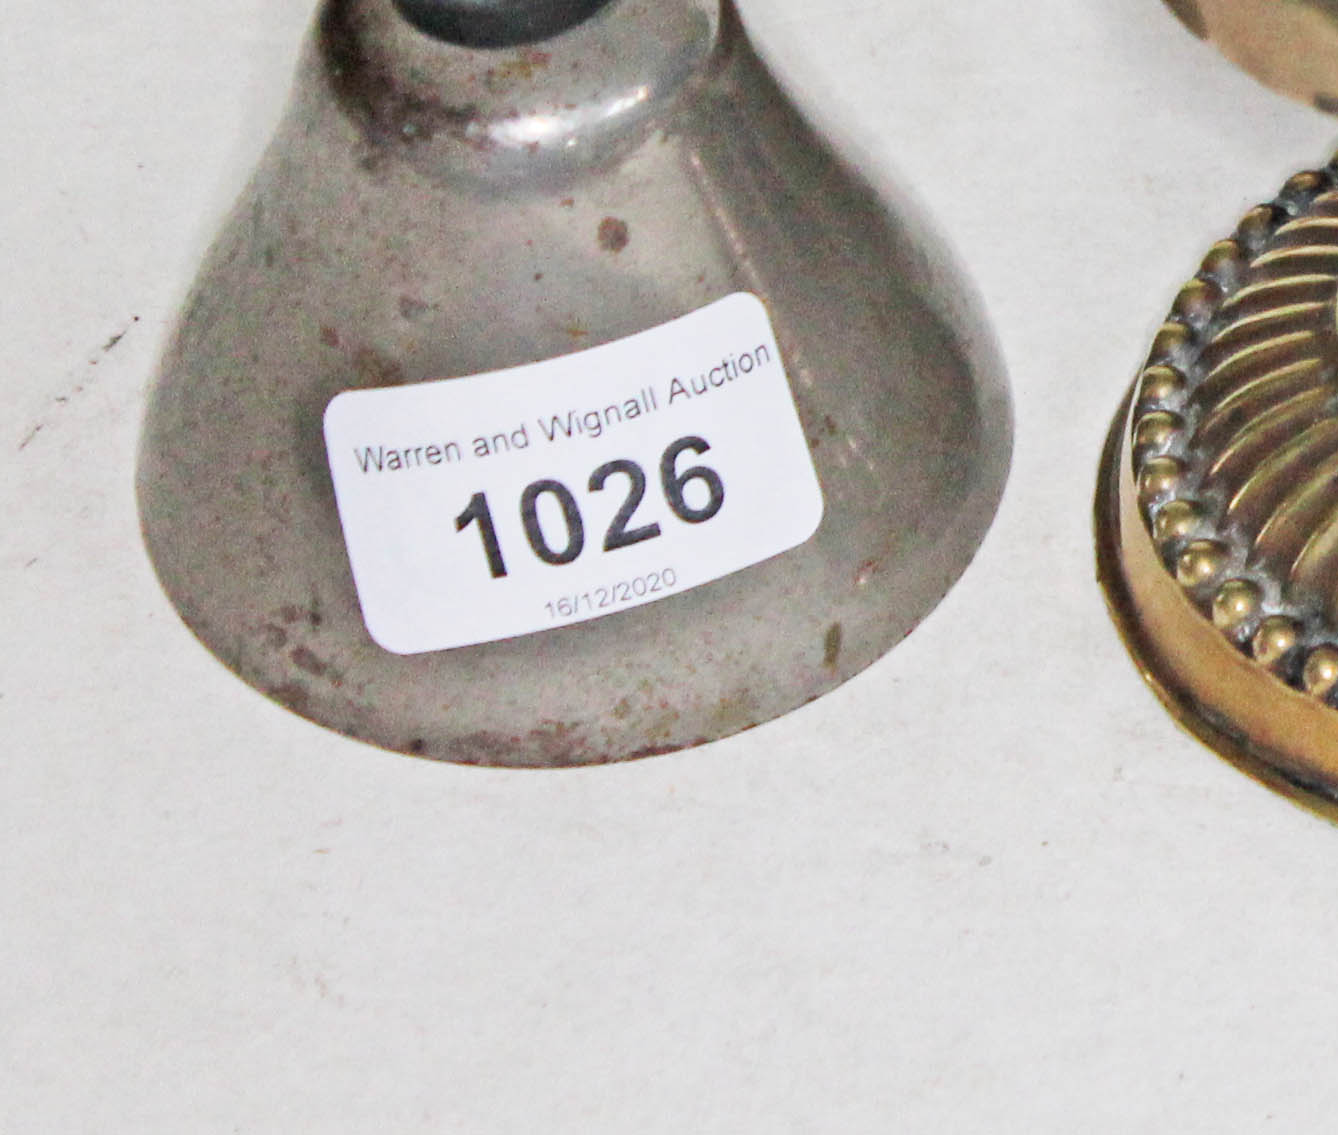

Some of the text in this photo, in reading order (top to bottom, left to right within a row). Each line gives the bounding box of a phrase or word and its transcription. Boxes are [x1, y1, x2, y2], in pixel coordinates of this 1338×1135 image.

[353, 343, 771, 474] Warren and Wignall Auction
[454, 436, 725, 579] 1026
[544, 567, 678, 619] 16/12/2020
